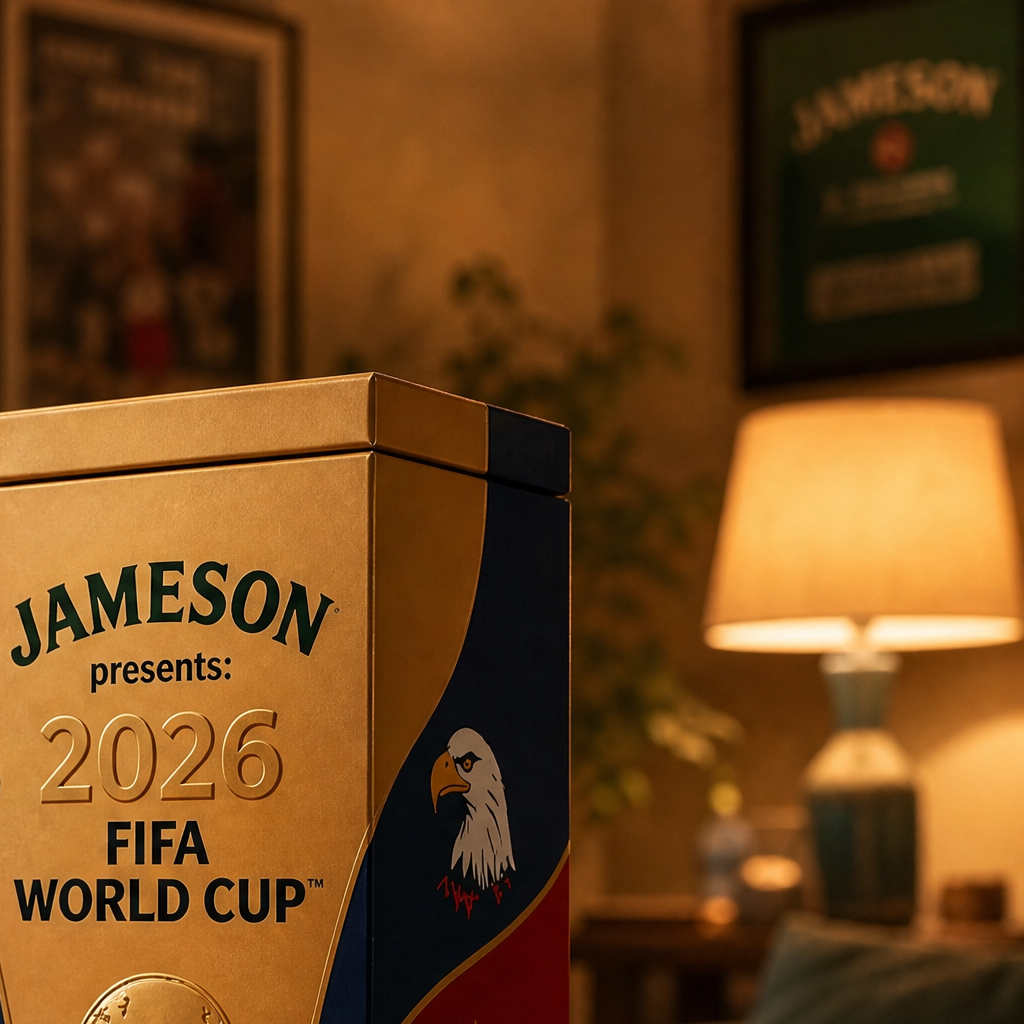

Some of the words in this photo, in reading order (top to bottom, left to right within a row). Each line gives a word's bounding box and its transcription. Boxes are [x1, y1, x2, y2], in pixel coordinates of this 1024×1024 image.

[11, 560, 335, 667] JAMESON
[90, 652, 232, 693] presents:
[40, 708, 283, 804] 2026
[107, 820, 210, 865] FIFA
[13, 878, 190, 922] WORLD
